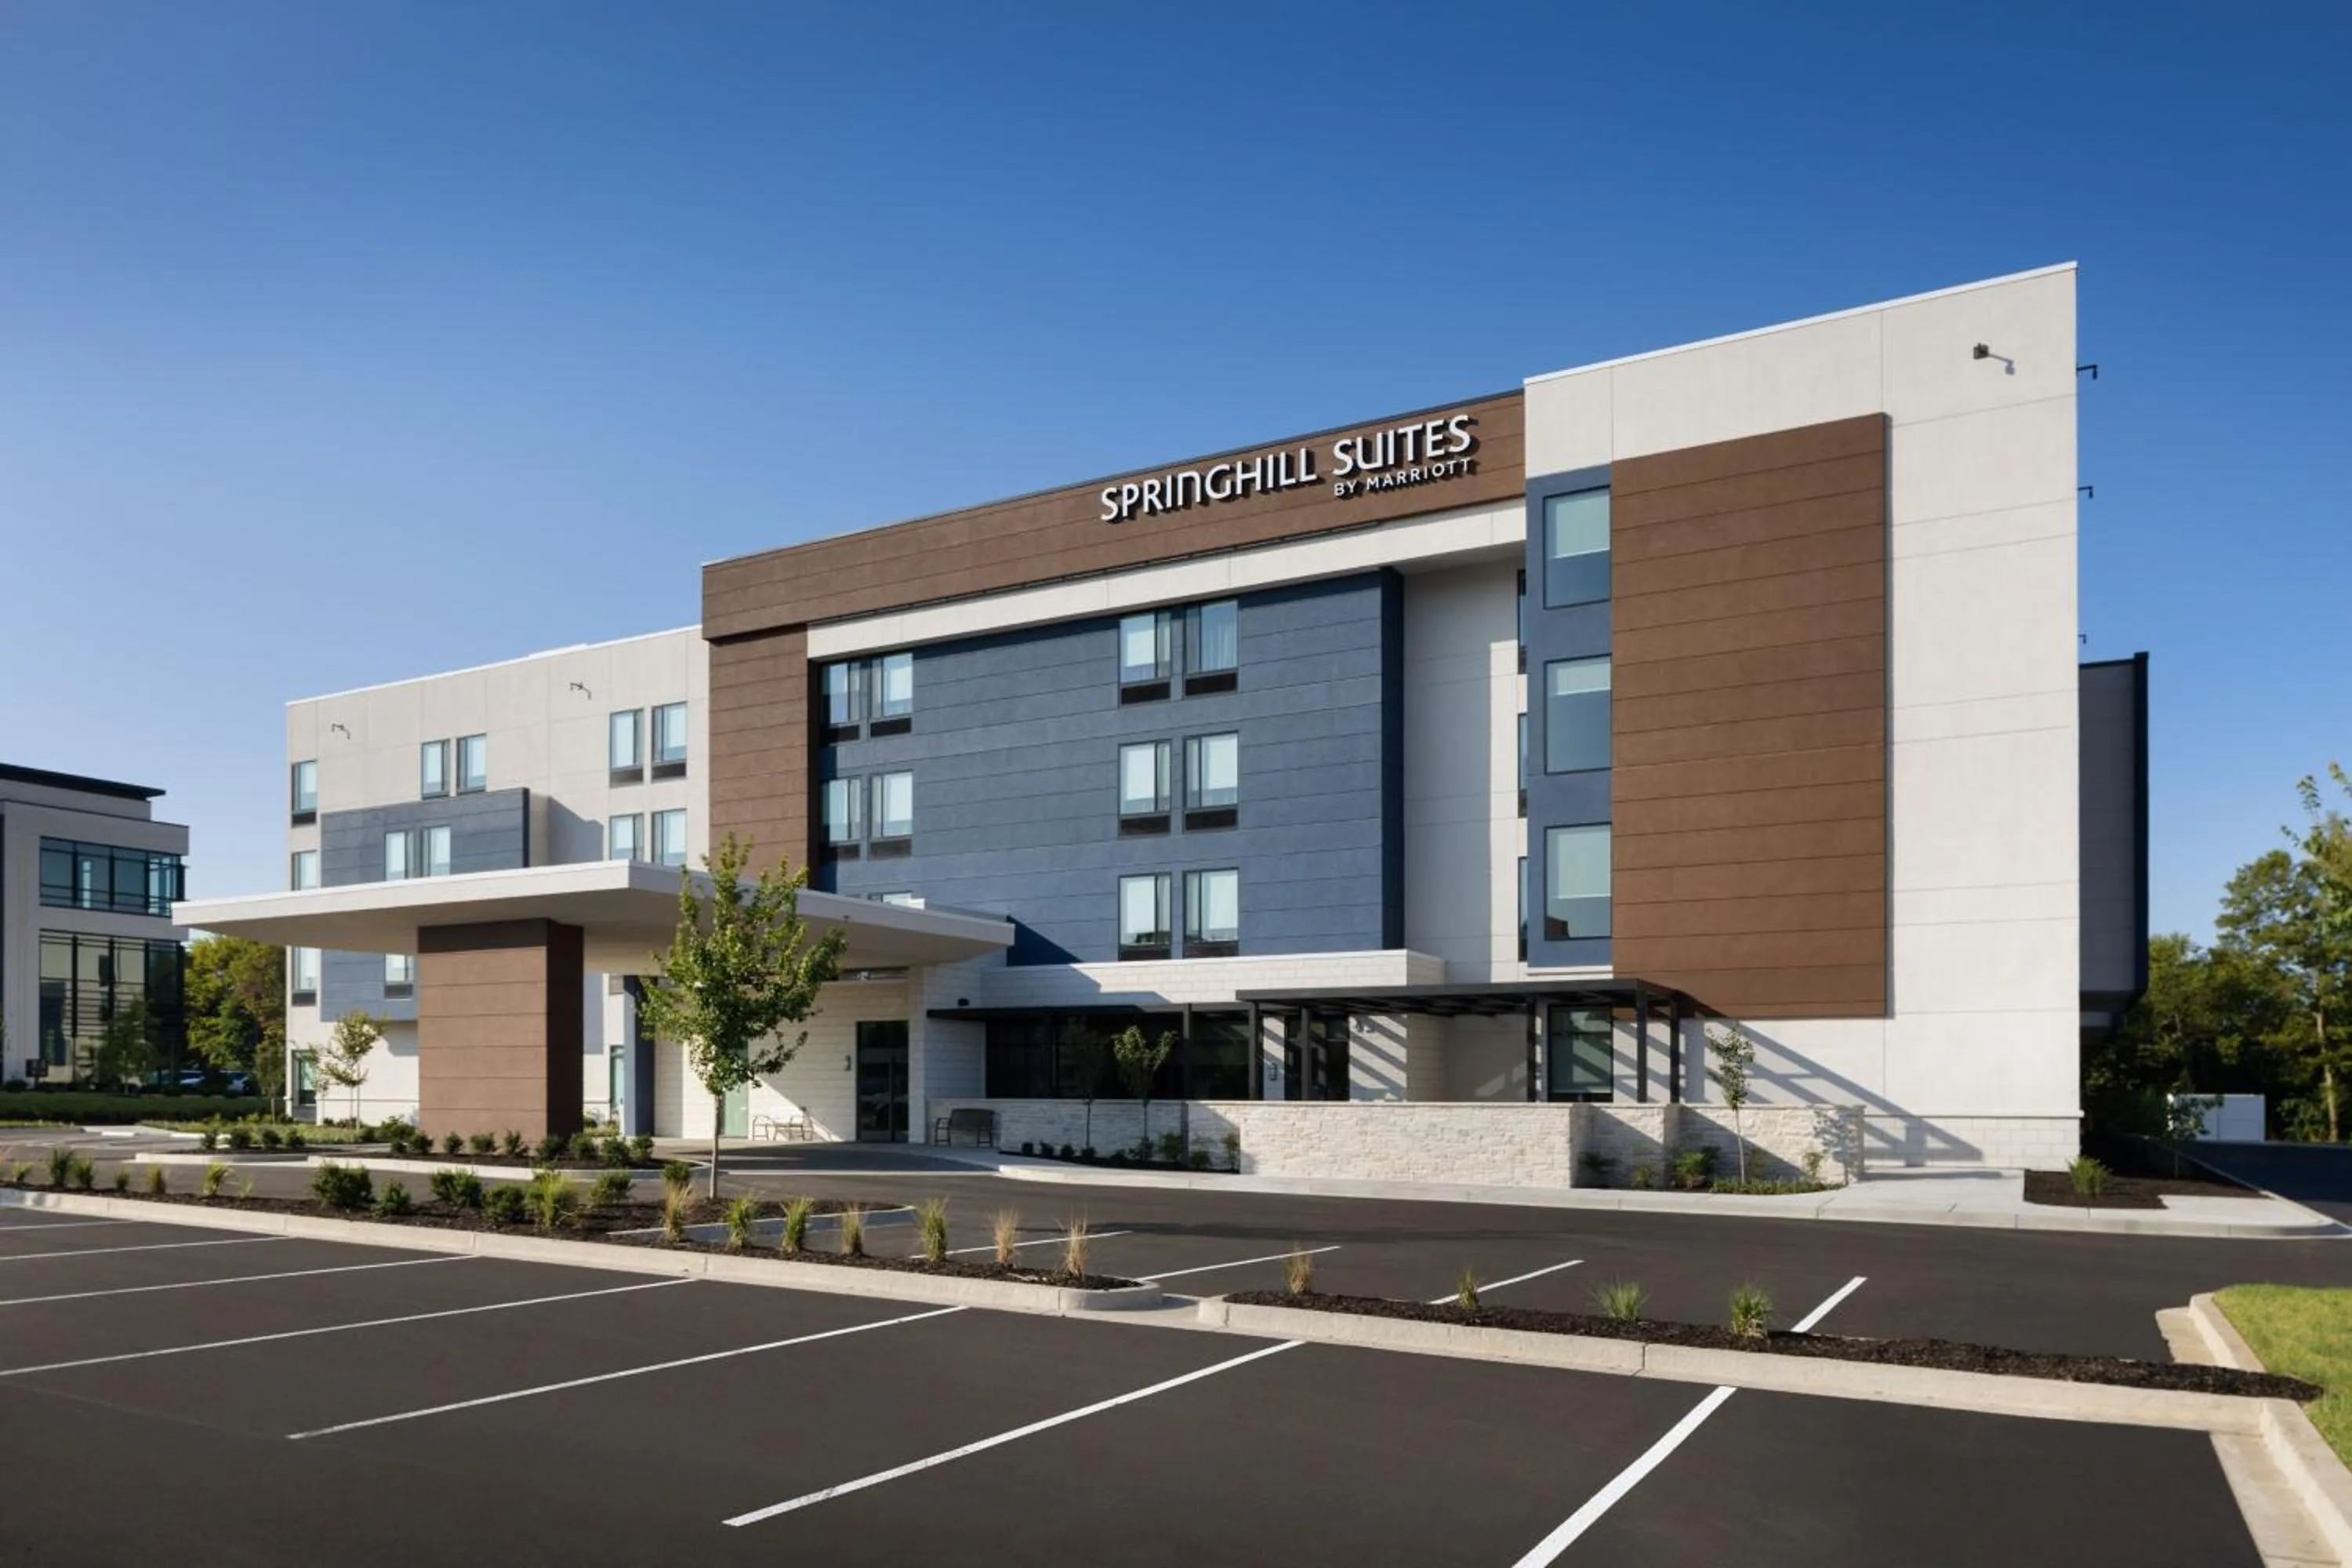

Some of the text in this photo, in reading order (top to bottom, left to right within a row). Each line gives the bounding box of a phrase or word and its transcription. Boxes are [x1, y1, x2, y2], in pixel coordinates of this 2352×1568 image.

[1100, 414, 1470, 521] SPRINGHILL SUITES
[1334, 457, 1472, 497] BY MARRIOTT
